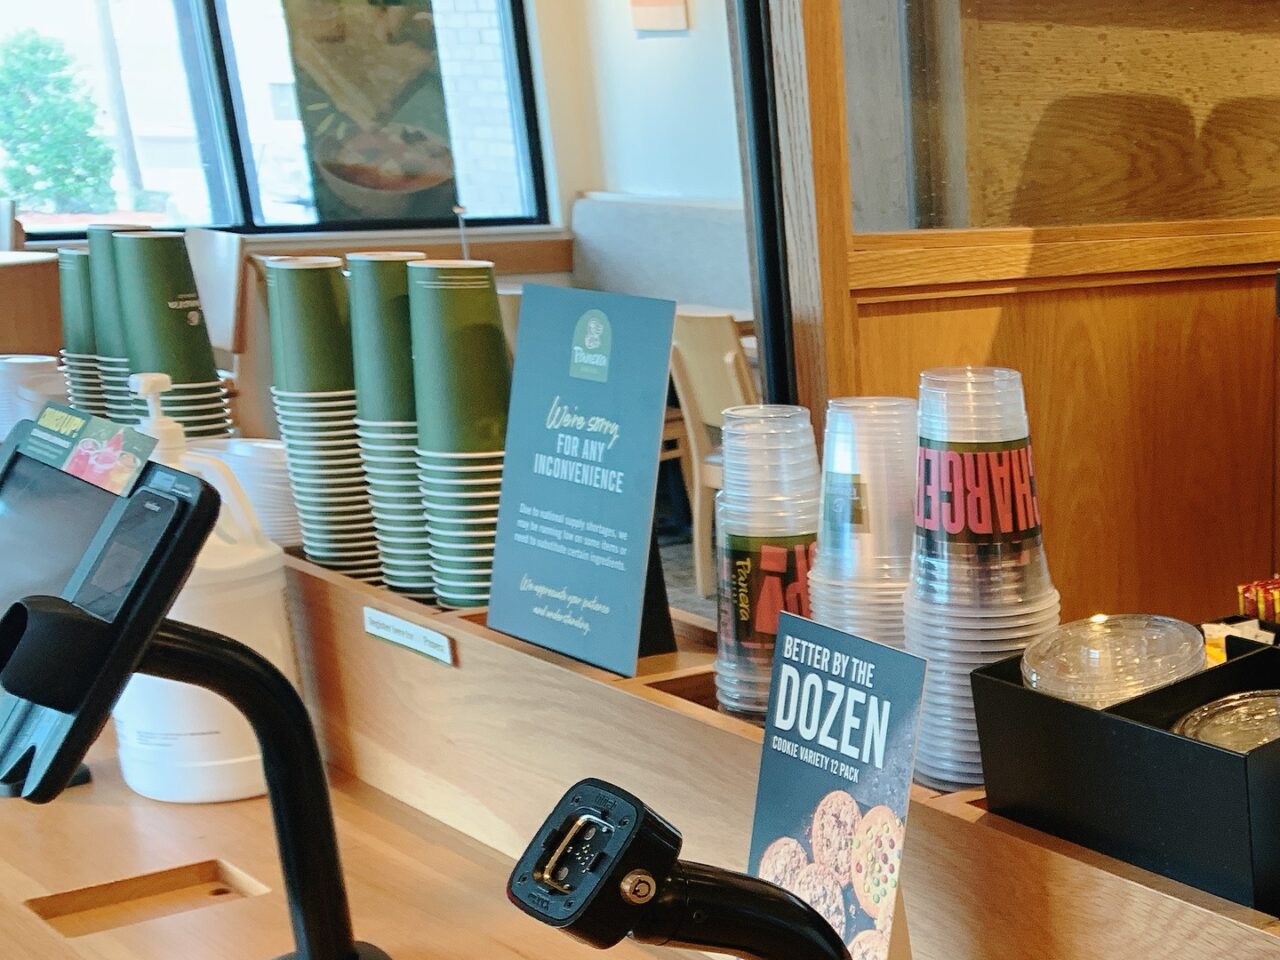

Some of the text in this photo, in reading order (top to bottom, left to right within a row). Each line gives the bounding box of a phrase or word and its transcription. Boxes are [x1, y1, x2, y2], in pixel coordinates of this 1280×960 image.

[556, 433, 605, 463] FOR ANY
[586, 415, 620, 449] sorry
[533, 453, 624, 494] INCONVENIENCE
[736, 557, 752, 621] Panera
[784, 635, 876, 689] BETTER BY THE
[773, 663, 891, 770] DOZEN
[772, 735, 860, 784] COOKIE VARIETY 12 PACK
